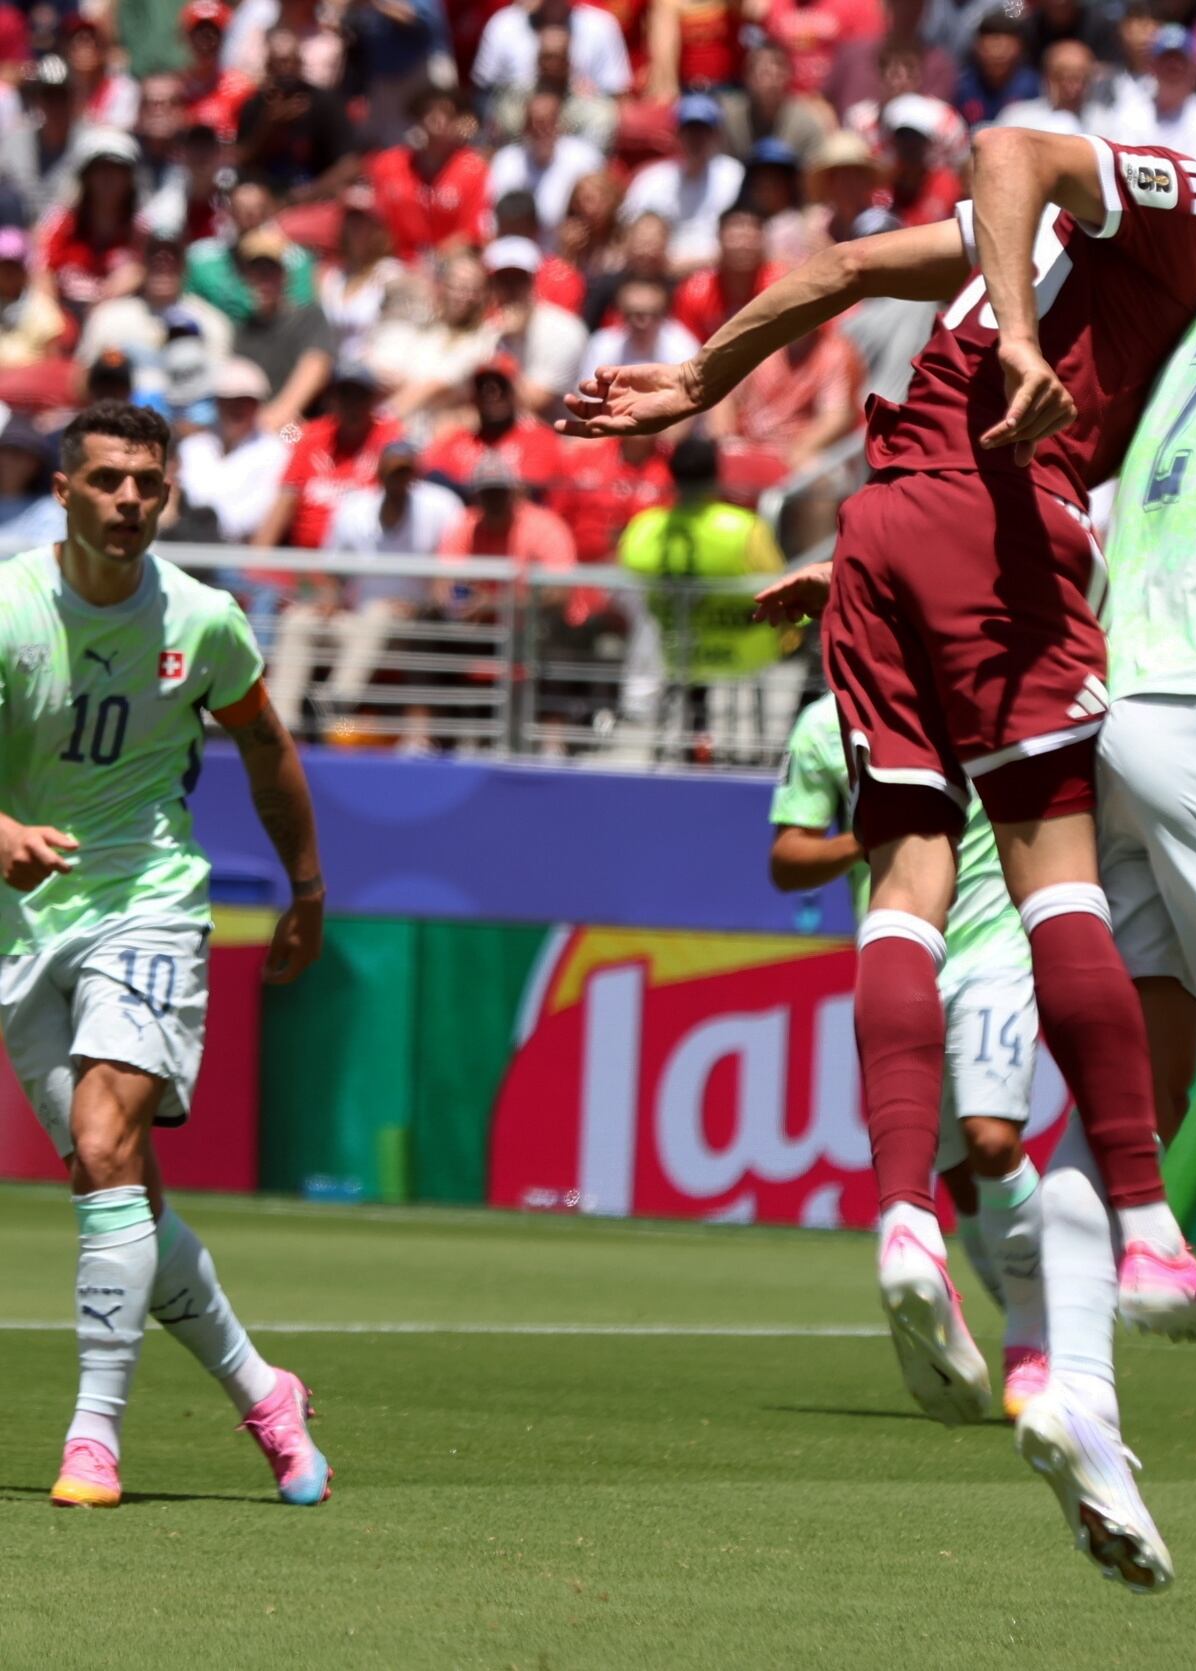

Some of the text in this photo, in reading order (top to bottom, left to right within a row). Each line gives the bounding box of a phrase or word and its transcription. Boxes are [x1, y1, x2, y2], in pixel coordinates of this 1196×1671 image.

[59, 692, 131, 766] 10
[118, 949, 176, 1019] 10
[973, 1007, 1025, 1068] 14
